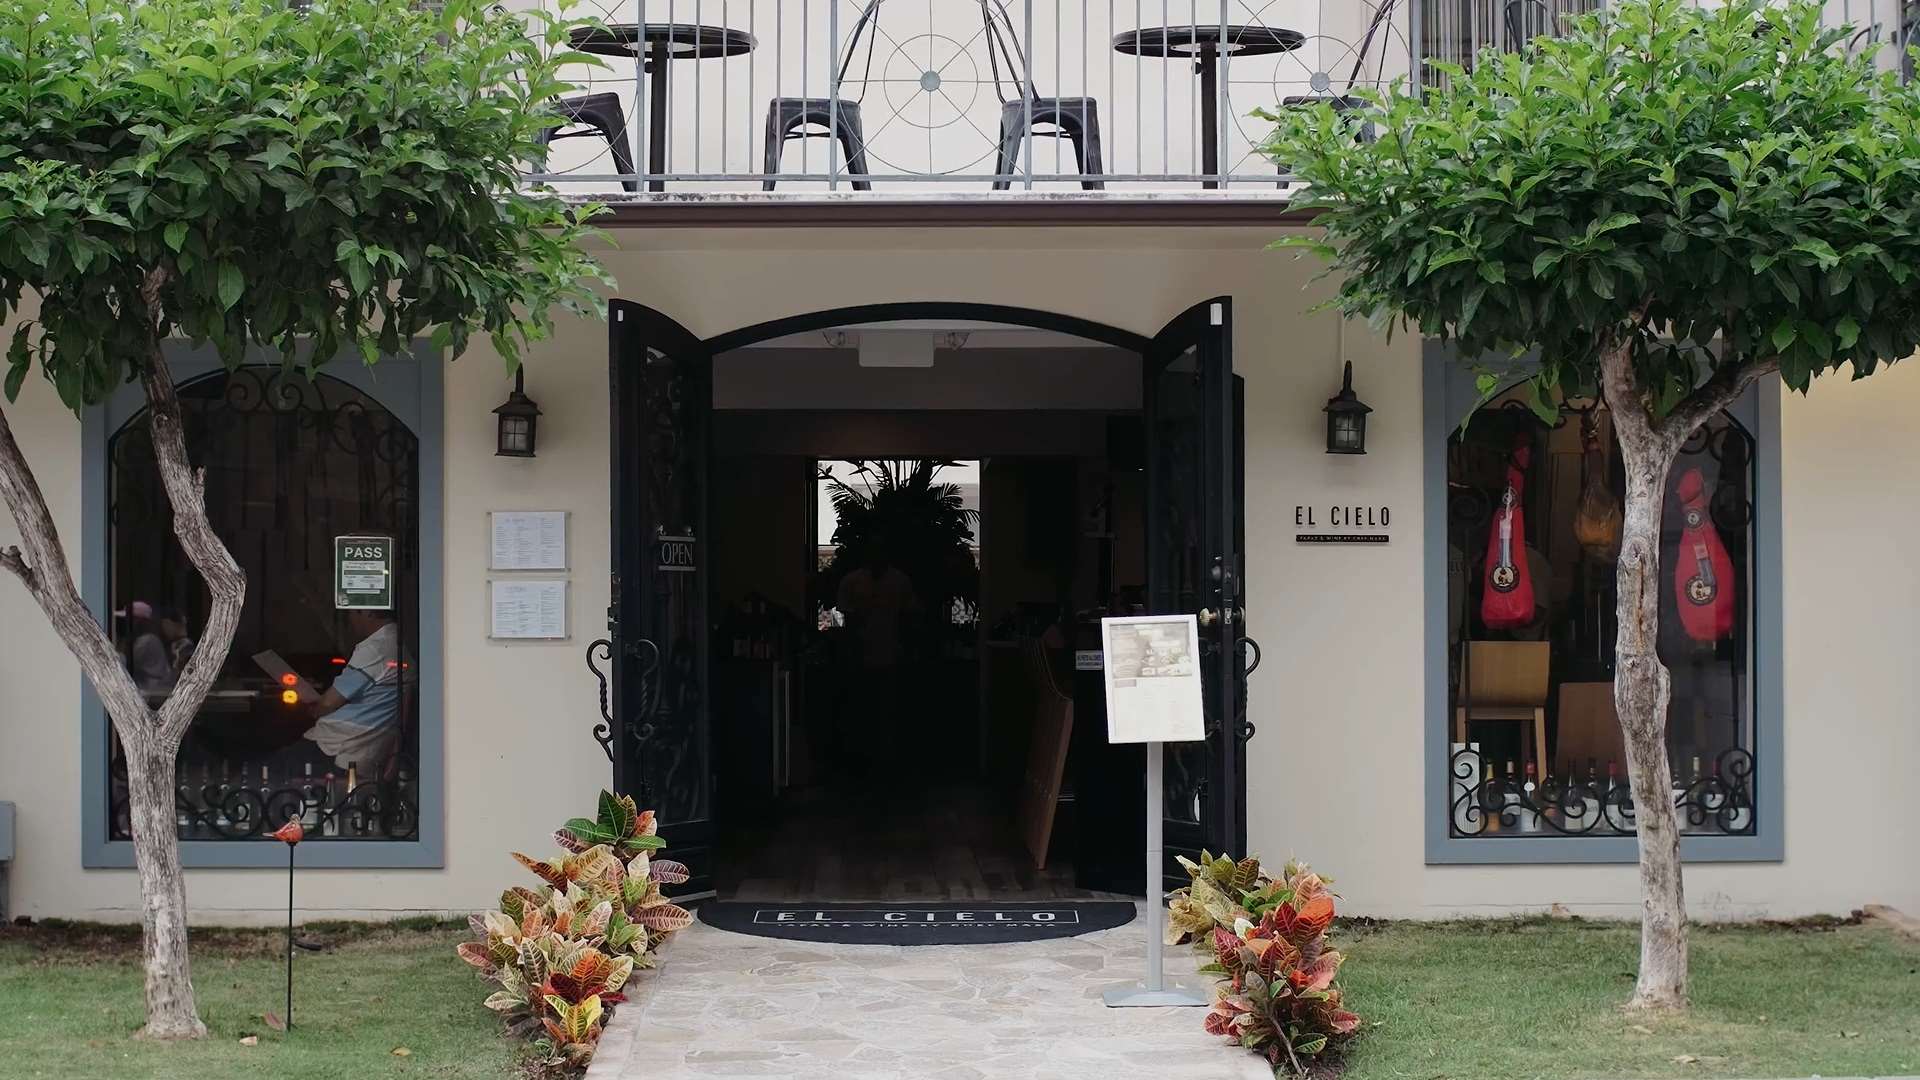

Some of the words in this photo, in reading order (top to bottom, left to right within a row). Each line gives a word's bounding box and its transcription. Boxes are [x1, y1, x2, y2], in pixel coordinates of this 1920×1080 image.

[1295, 506, 1316, 525] EL
[1331, 506, 1389, 526] CIELO
[344, 547, 383, 558] PASS
[662, 542, 693, 565] OPEN
[777, 912, 833, 921] EL
[884, 912, 1056, 921] CIELO
